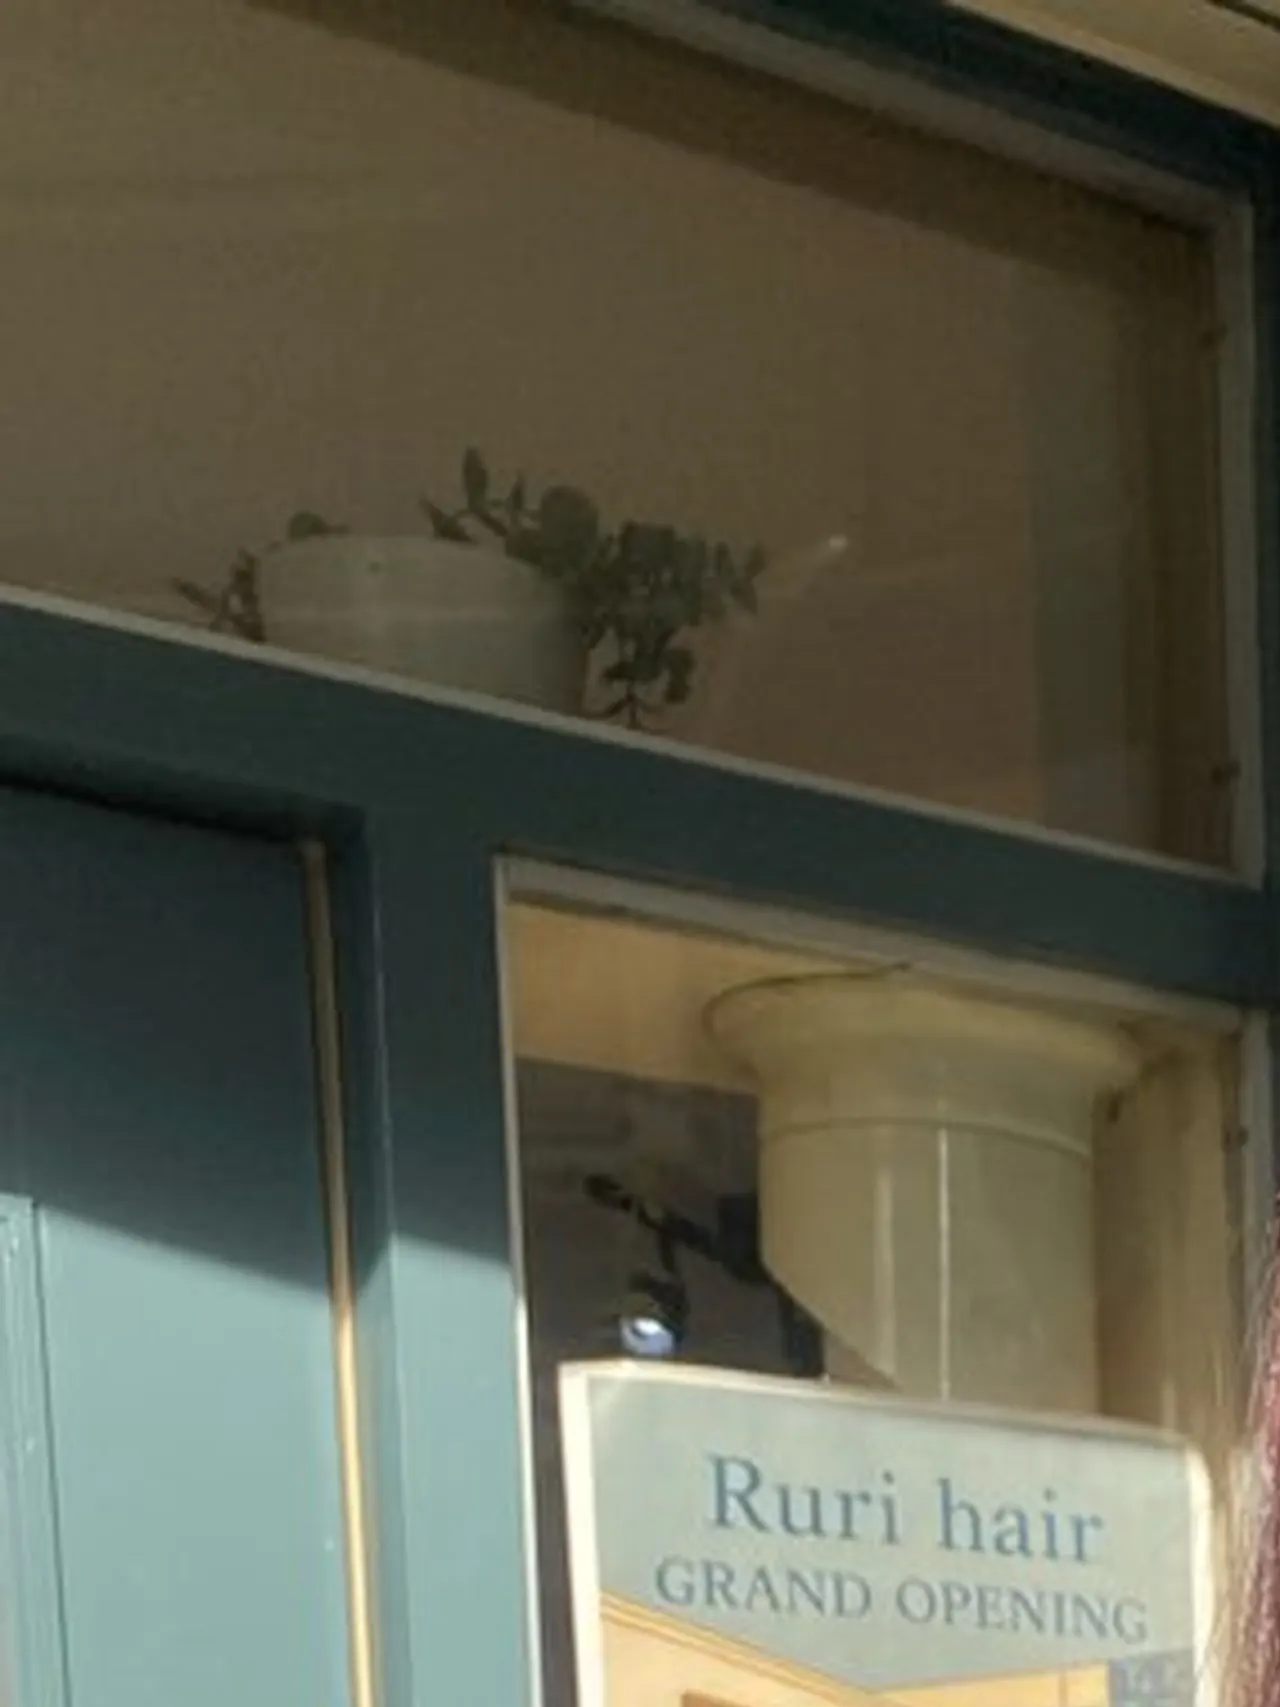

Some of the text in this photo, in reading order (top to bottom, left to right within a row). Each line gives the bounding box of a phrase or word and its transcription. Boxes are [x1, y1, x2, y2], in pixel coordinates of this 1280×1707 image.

[709, 1453, 1105, 1564] Ruri hair
[654, 1555, 1150, 1646] GRAND OPENING
